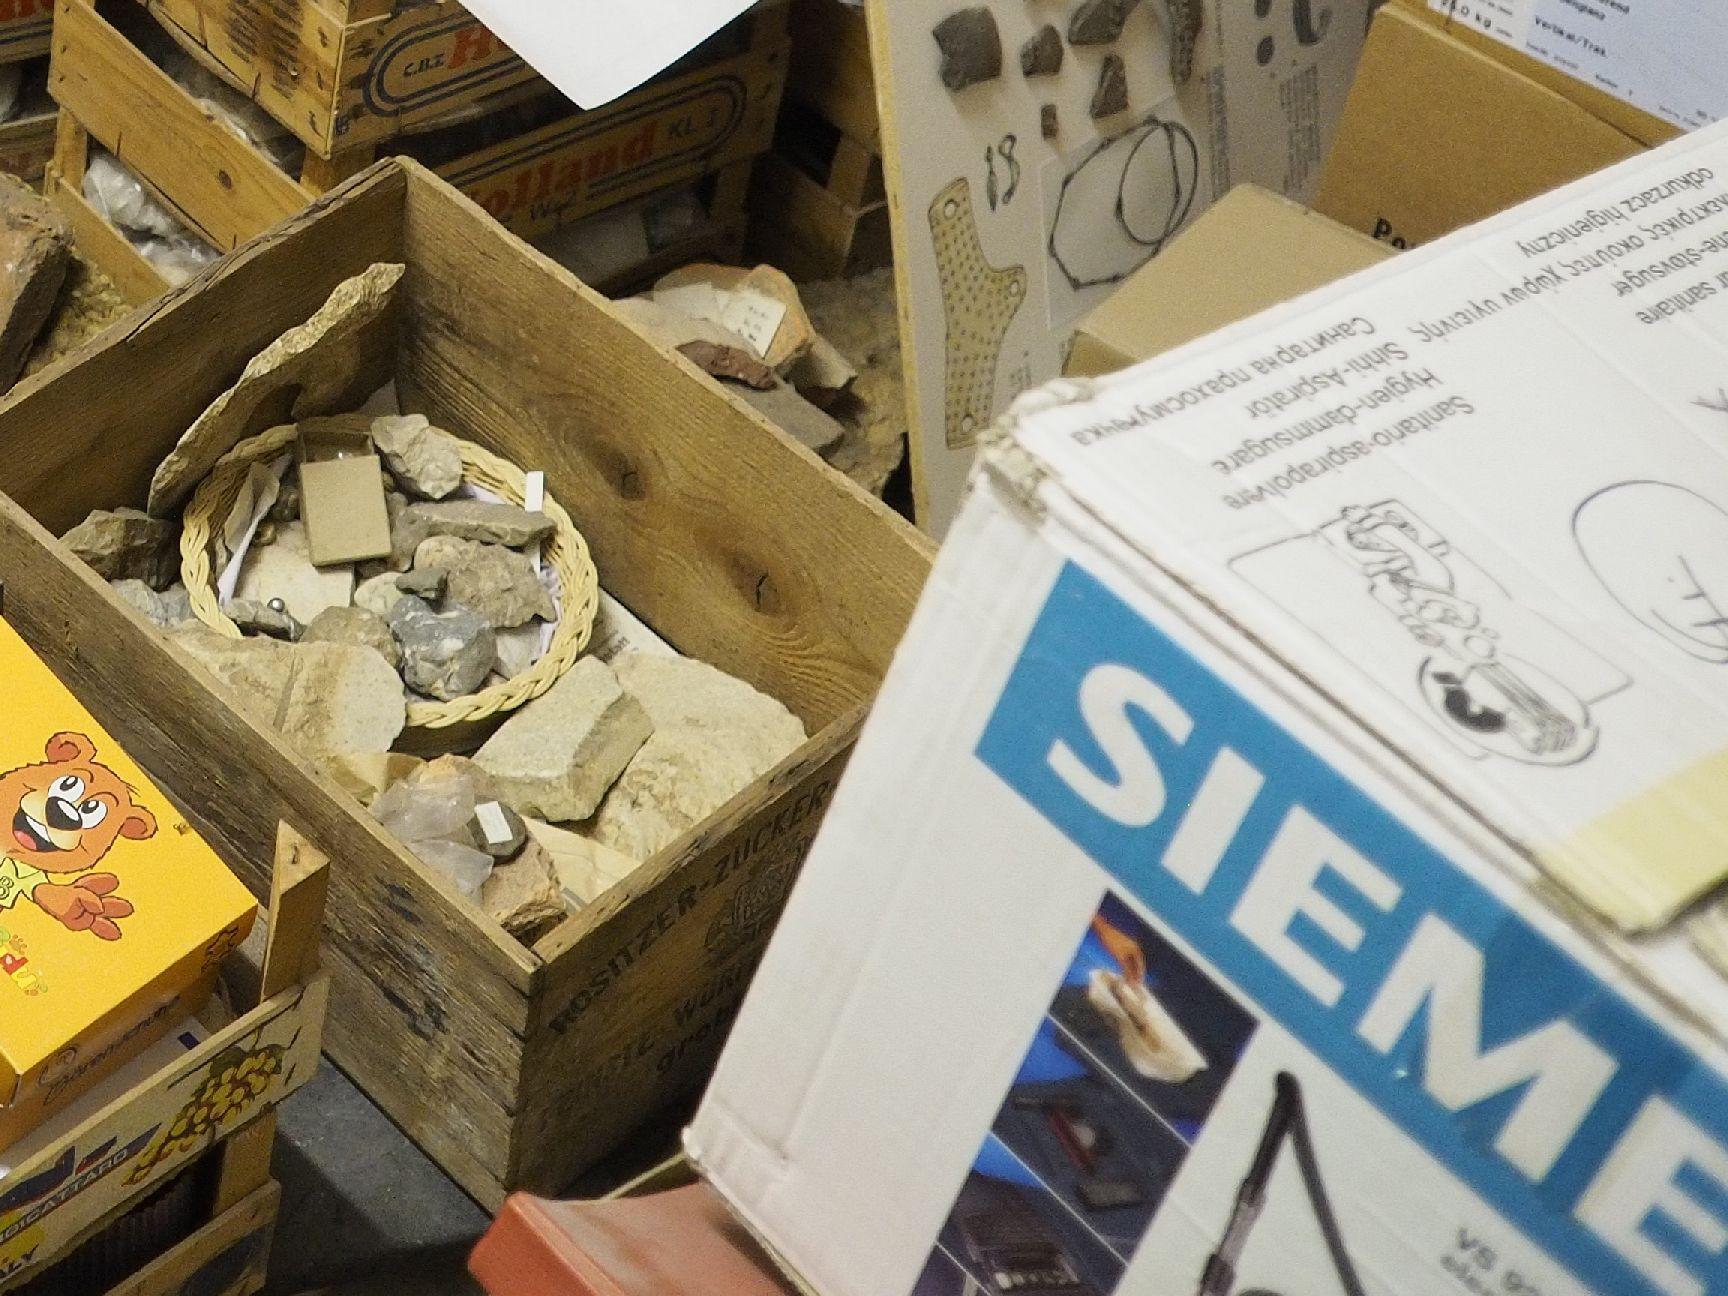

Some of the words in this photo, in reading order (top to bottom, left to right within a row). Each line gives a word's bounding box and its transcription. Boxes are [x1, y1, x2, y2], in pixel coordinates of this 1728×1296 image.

[1621, 166, 1715, 221] odkurzacz
[1516, 204, 1624, 261] higieniczny
[1634, 277, 1718, 327] sanitaire
